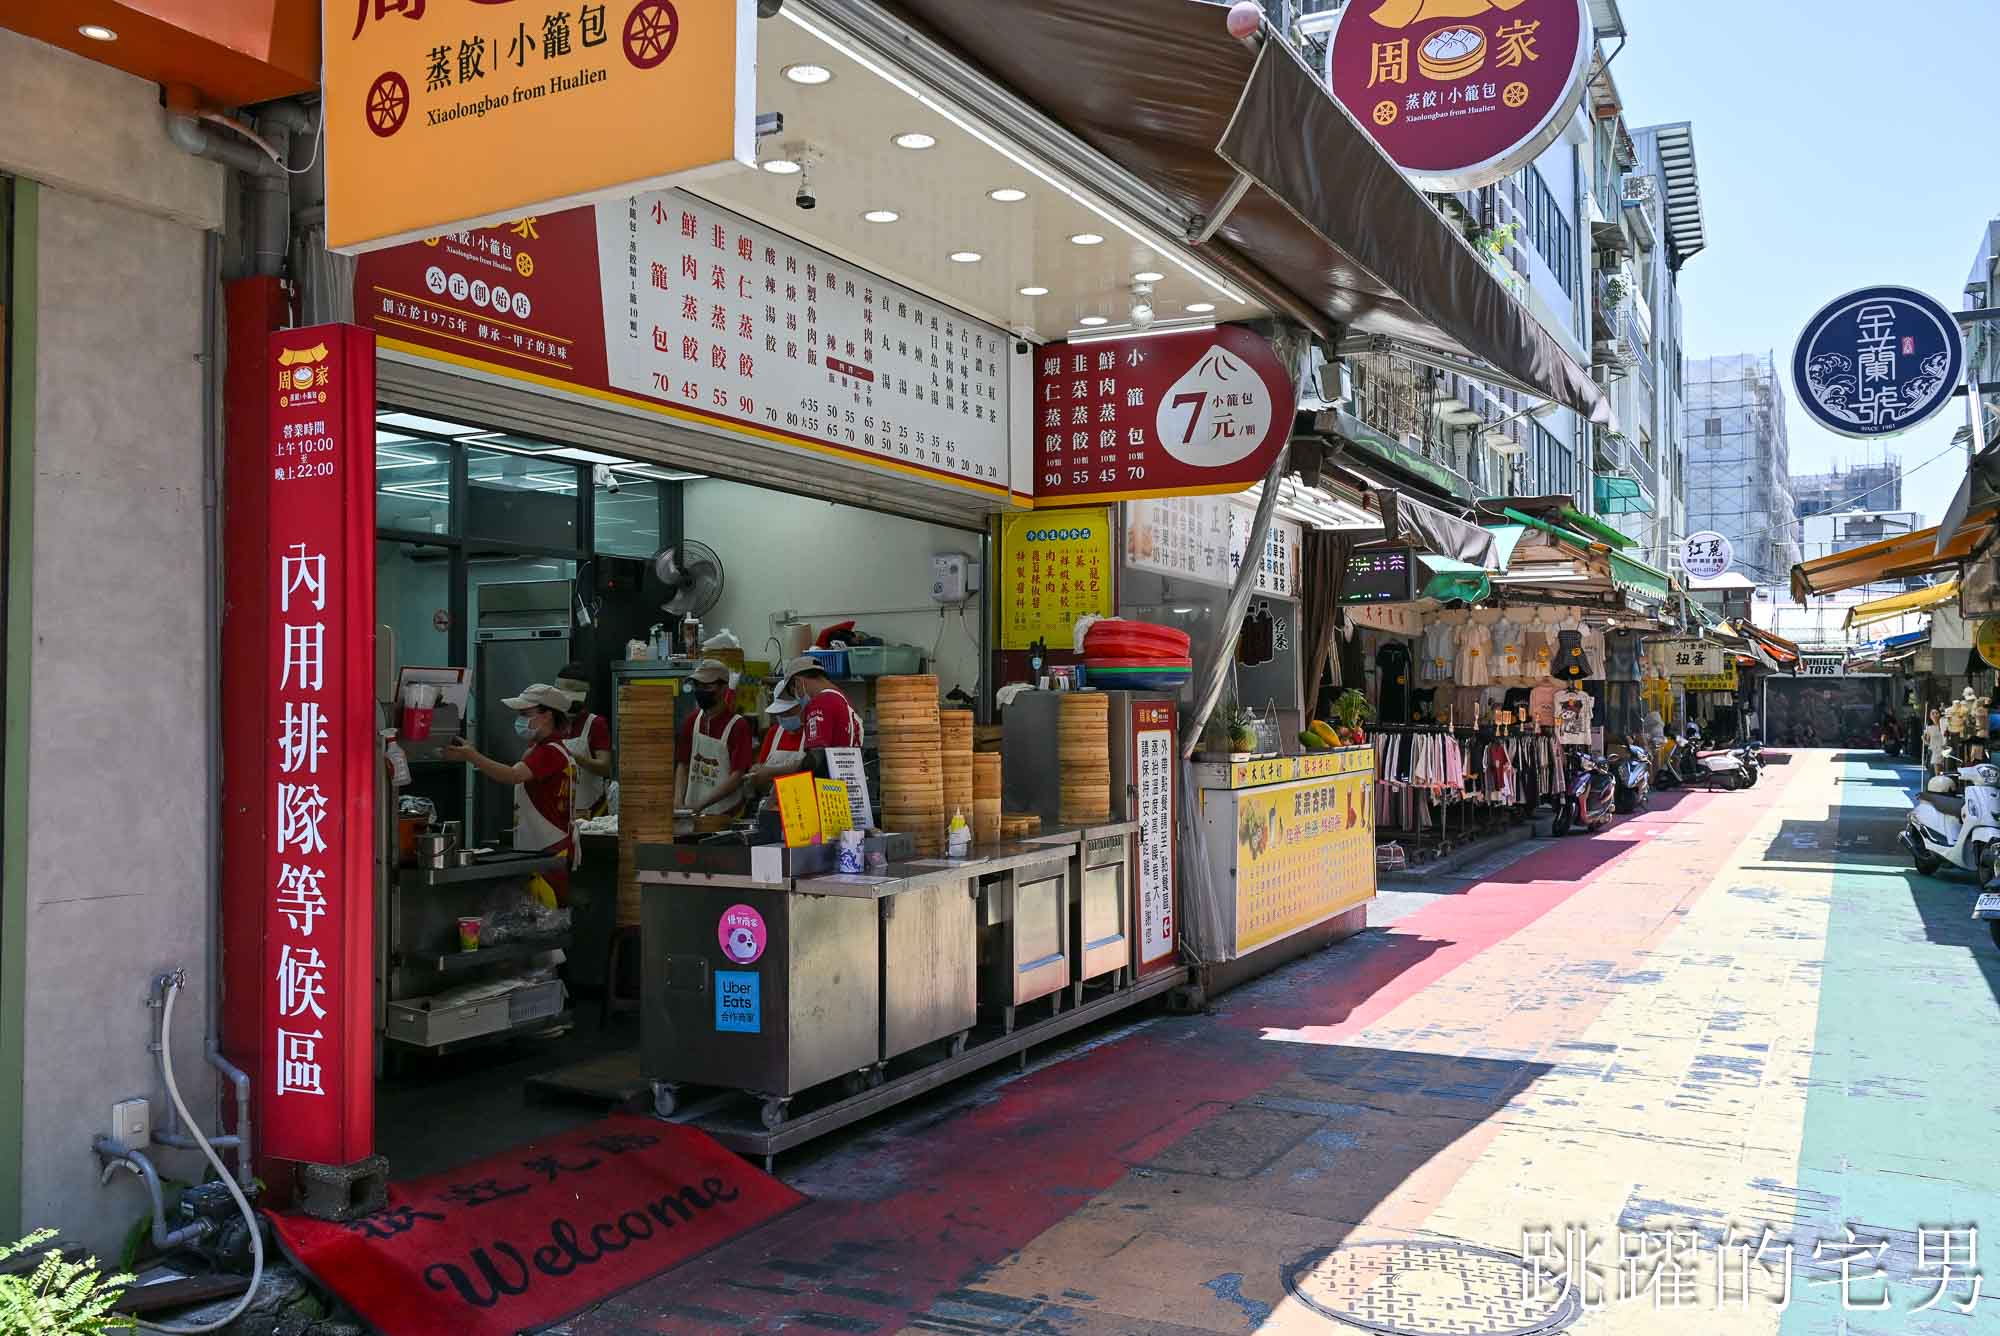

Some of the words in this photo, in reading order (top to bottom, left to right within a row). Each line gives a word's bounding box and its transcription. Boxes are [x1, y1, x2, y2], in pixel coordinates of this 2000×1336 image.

[1366, 37, 1410, 89] 周
[1496, 19, 1541, 68] 家
[427, 94, 509, 127] Xiaolongbao
[513, 83, 546, 104] from
[550, 68, 607, 94] Hualien
[1406, 110, 1448, 123] Xiaolongbao
[1450, 107, 1466, 117] from
[1467, 104, 1496, 115] Hualien
[651, 200, 668, 353] 小籠包
[430, 271, 528, 316] 公正創始店
[681, 212, 698, 362] 鮮肉蒸餃
[711, 224, 726, 370] 韭菜蒸餃
[765, 247, 776, 353] 酸辣湯餃
[738, 235, 753, 378] 蝦仁蒸餃
[881, 295, 890, 389] 貢丸湯
[278, 370, 291, 391] 周
[315, 365, 329, 387] 家
[960, 328, 969, 416] 古早味紅茶
[652, 373, 669, 392] 70
[682, 381, 698, 399] 45
[1127, 348, 1145, 446] 小籠包
[712, 389, 727, 406] 55
[1043, 356, 1062, 453] 蝦仁蒸餃
[1071, 354, 1089, 450] 韭菜蒸餃
[1098, 351, 1117, 449] 鮮肉蒸餃
[1212, 393, 1254, 408] 小籠包
[739, 396, 753, 414] 90
[827, 404, 838, 418] 50
[765, 407, 777, 422] 70
[786, 412, 798, 426] 80
[845, 410, 855, 423] 55
[1172, 391, 1207, 444] 7
[864, 416, 874, 429] 65
[882, 420, 891, 433] 25
[283, 421, 325, 439] 營業時間
[827, 423, 838, 437] 65
[845, 428, 855, 442] 70
[899, 426, 908, 438] 25
[864, 433, 874, 447] 80
[882, 438, 891, 450] 50
[916, 431, 925, 444] 35
[931, 435, 940, 448] 35
[275, 441, 296, 457] 上午
[298, 437, 334, 453] 10:00
[899, 443, 908, 455] 50
[946, 440, 955, 452] 45
[916, 447, 925, 460] 70
[931, 451, 940, 464] 70
[946, 455, 955, 468] 90
[961, 459, 970, 472] 20
[275, 466, 296, 481] 晚上
[297, 462, 334, 478] 22:00
[975, 463, 983, 476] 20
[989, 466, 997, 478] 20
[1099, 469, 1116, 482] 45
[1127, 466, 1145, 480] 70
[1045, 473, 1062, 487] 90
[1072, 471, 1088, 484] 55
[1676, 652, 1705, 666] 扭蛋
[1809, 665, 1834, 674] TOYS
[276, 542, 328, 1096] 內用排隊等候區
[723, 982, 752, 994] Uber
[723, 995, 752, 1008] Eats
[425, 1176, 739, 1308] Welcome
